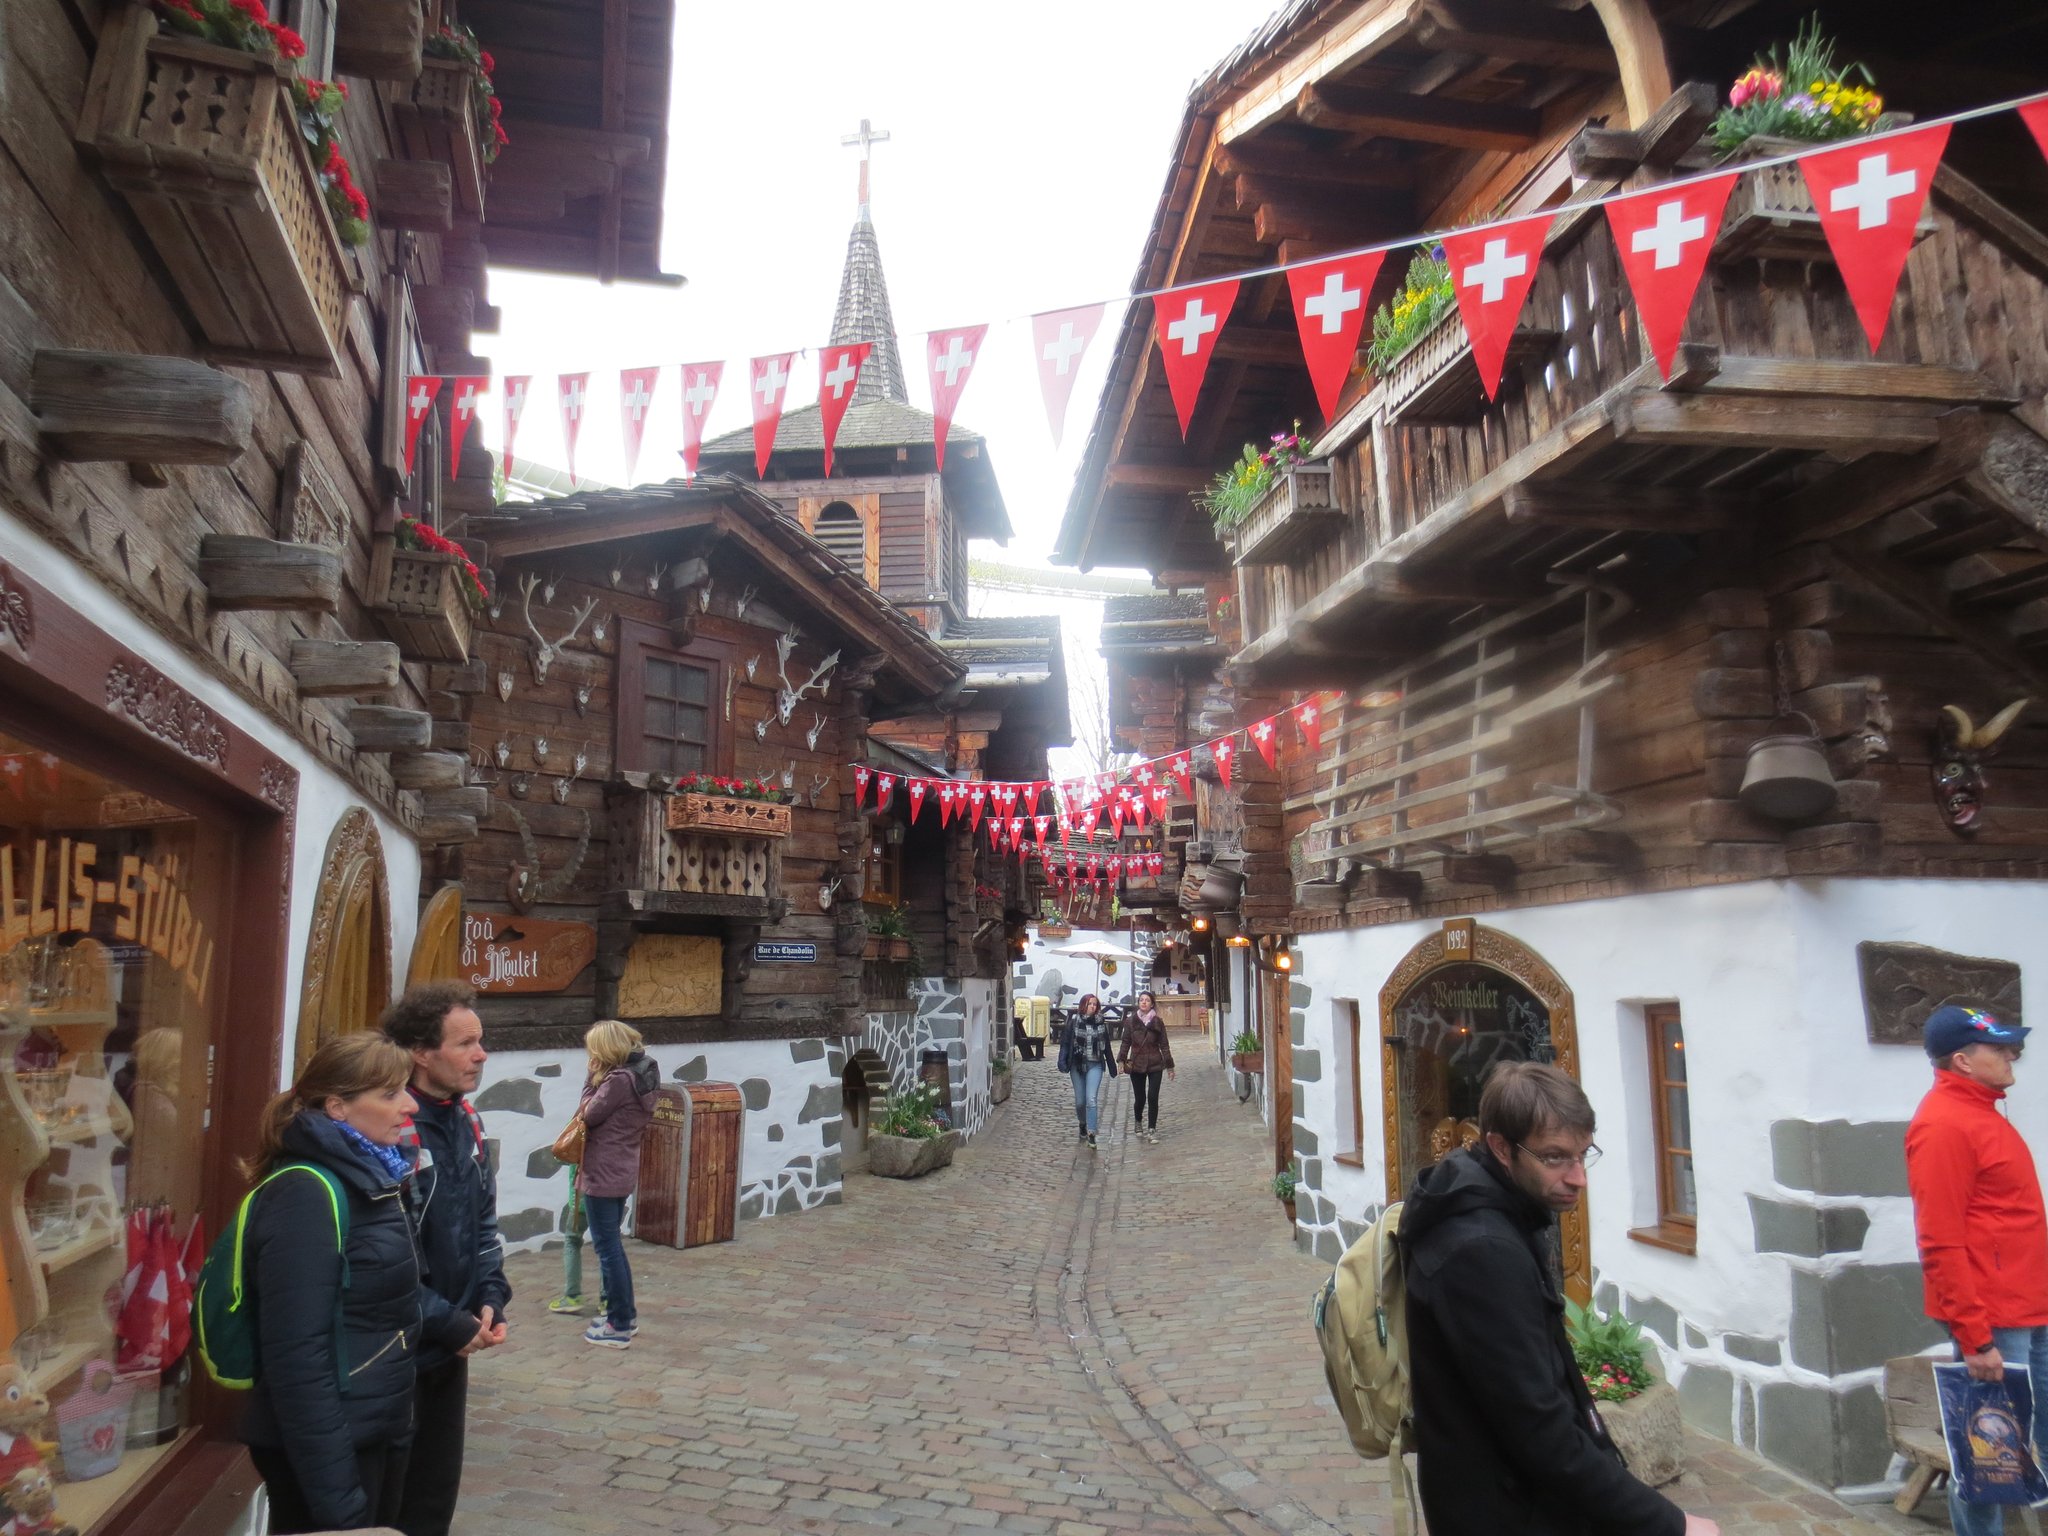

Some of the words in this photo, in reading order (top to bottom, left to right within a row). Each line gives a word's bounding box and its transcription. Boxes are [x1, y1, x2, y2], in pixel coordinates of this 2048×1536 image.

[758, 945, 771, 954] Rue
[772, 945, 780, 954] de
[781, 946, 814, 955] Chandolin
[1447, 930, 1467, 950] 1992
[1431, 981, 1498, 1009] Weinkeller
